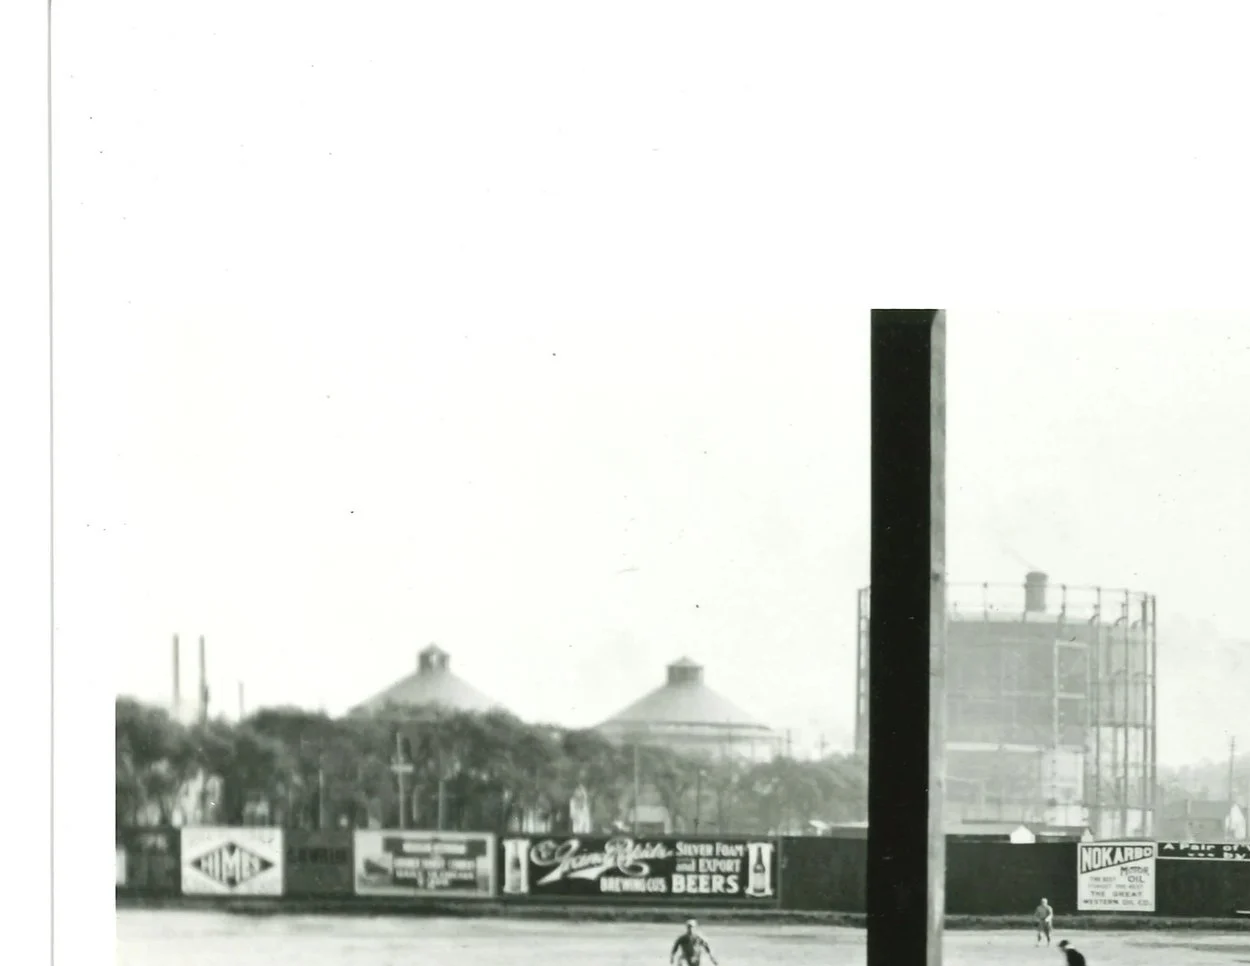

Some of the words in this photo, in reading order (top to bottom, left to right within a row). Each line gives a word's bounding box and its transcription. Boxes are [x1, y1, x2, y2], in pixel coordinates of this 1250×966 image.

[1179, 843, 1215, 851] Pair
[1222, 844, 1240, 852] of
[1081, 846, 1153, 872] NOKARBO
[1223, 852, 1246, 860] by
[698, 858, 741, 873] EXPORT
[671, 873, 739, 893] BEERS
